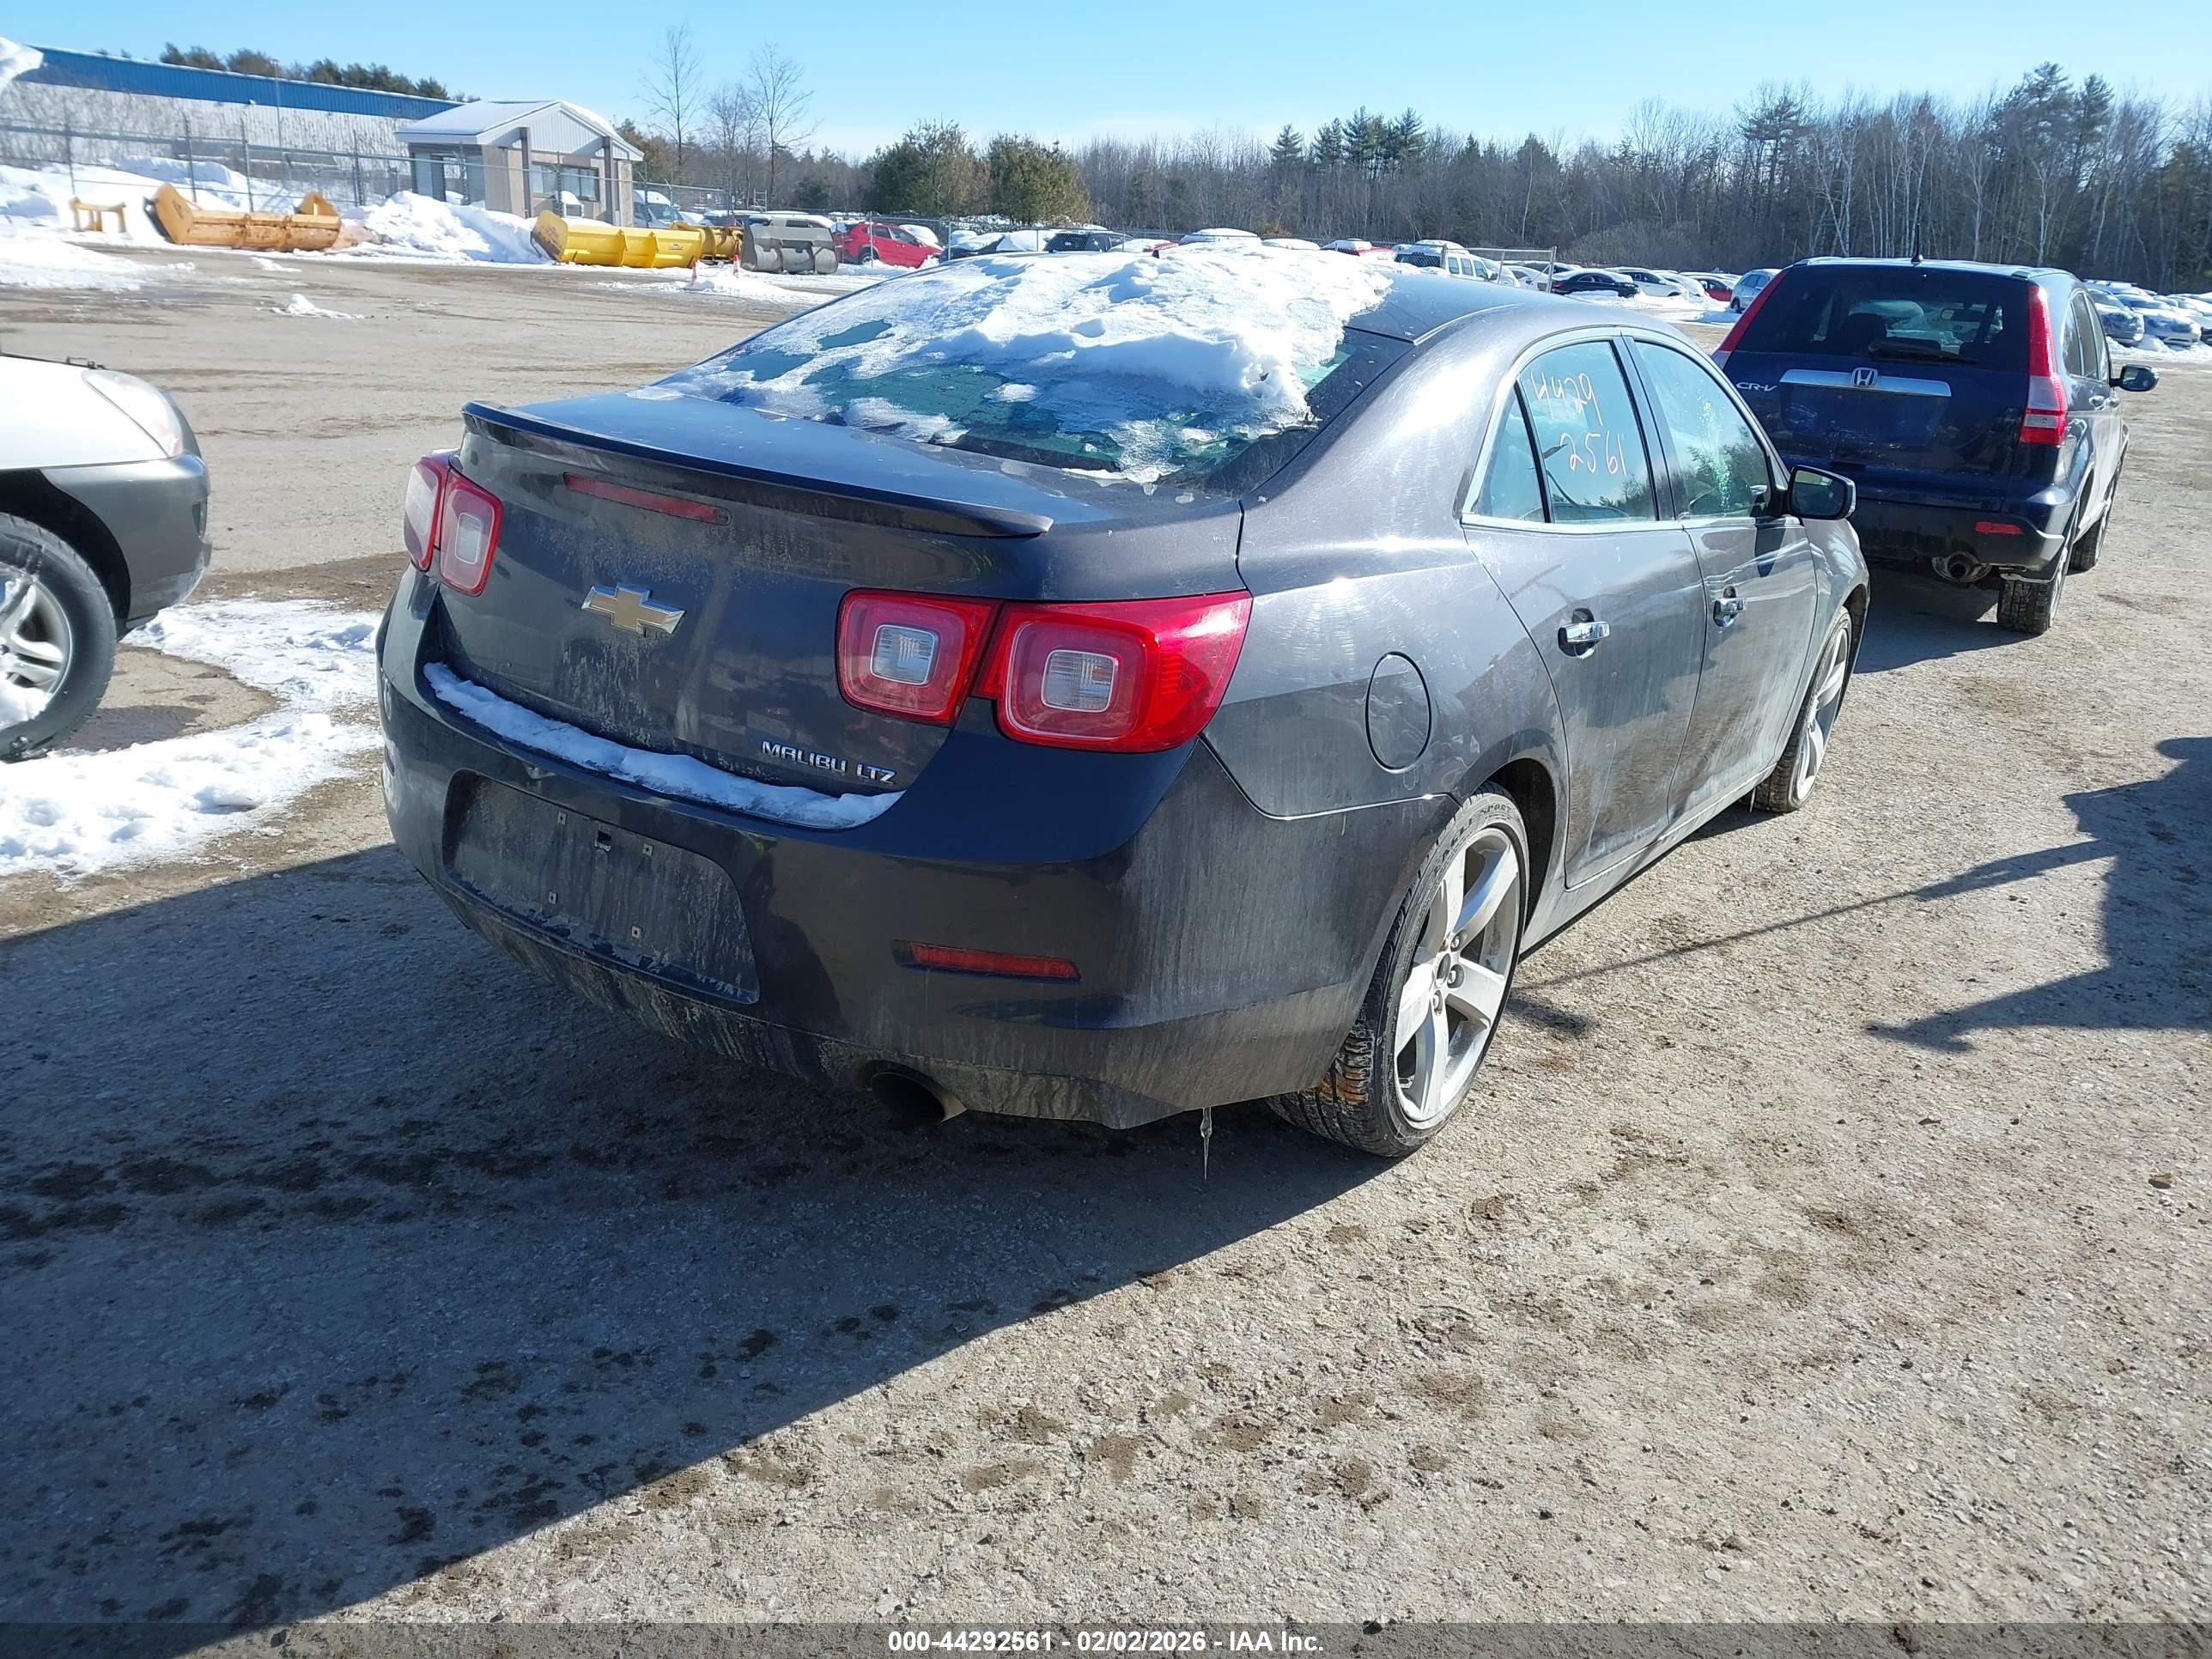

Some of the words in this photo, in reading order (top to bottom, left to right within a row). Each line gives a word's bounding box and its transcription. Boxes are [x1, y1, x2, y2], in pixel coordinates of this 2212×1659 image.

[1529, 370, 1604, 428] 4429
[1735, 381, 1779, 392] CR-V
[1559, 429, 1627, 476] 2561
[762, 740, 847, 773] MALIBU
[857, 763, 896, 785] LTZ
